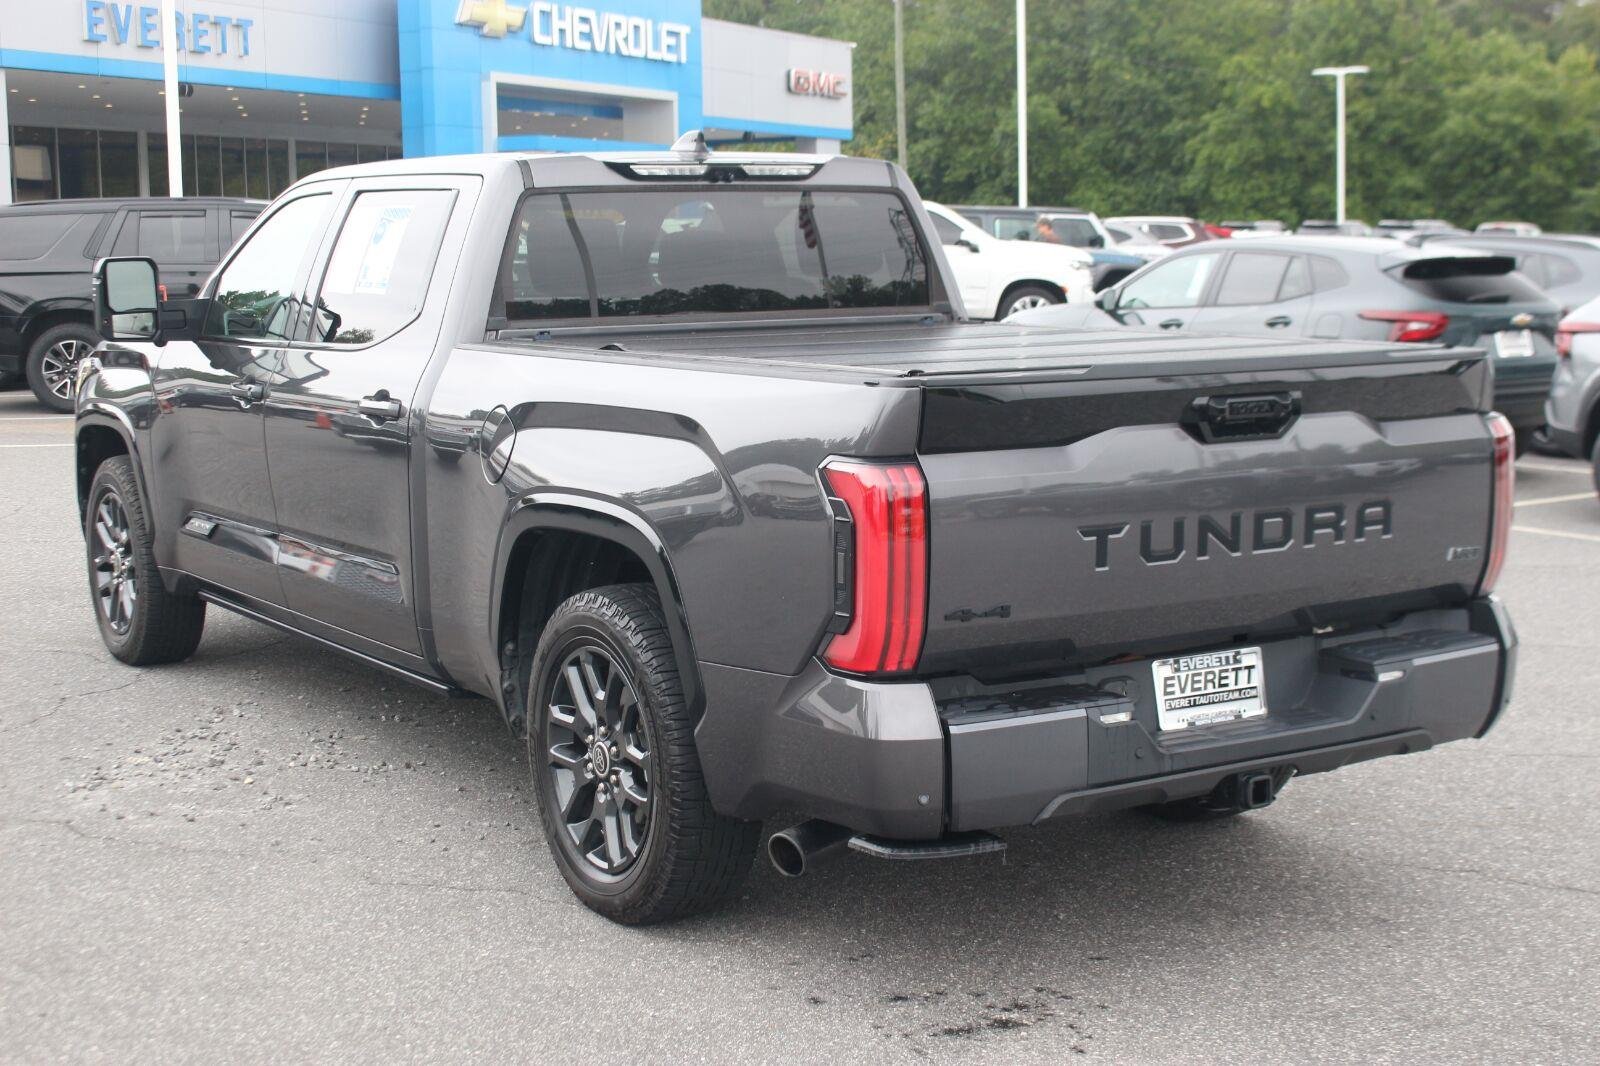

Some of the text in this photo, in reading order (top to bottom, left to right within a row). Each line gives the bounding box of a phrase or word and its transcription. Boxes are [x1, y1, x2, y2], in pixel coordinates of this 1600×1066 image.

[84, 0, 254, 56] EVERETT
[531, 2, 691, 64] CHEVROLET
[788, 68, 848, 98] GMC
[1077, 499, 1394, 572] TUNDRA
[1179, 652, 1236, 671] EVERETT
[1163, 665, 1256, 697] EVERETT
[1165, 688, 1258, 710] EVERETTAUTOTEAM.COM
